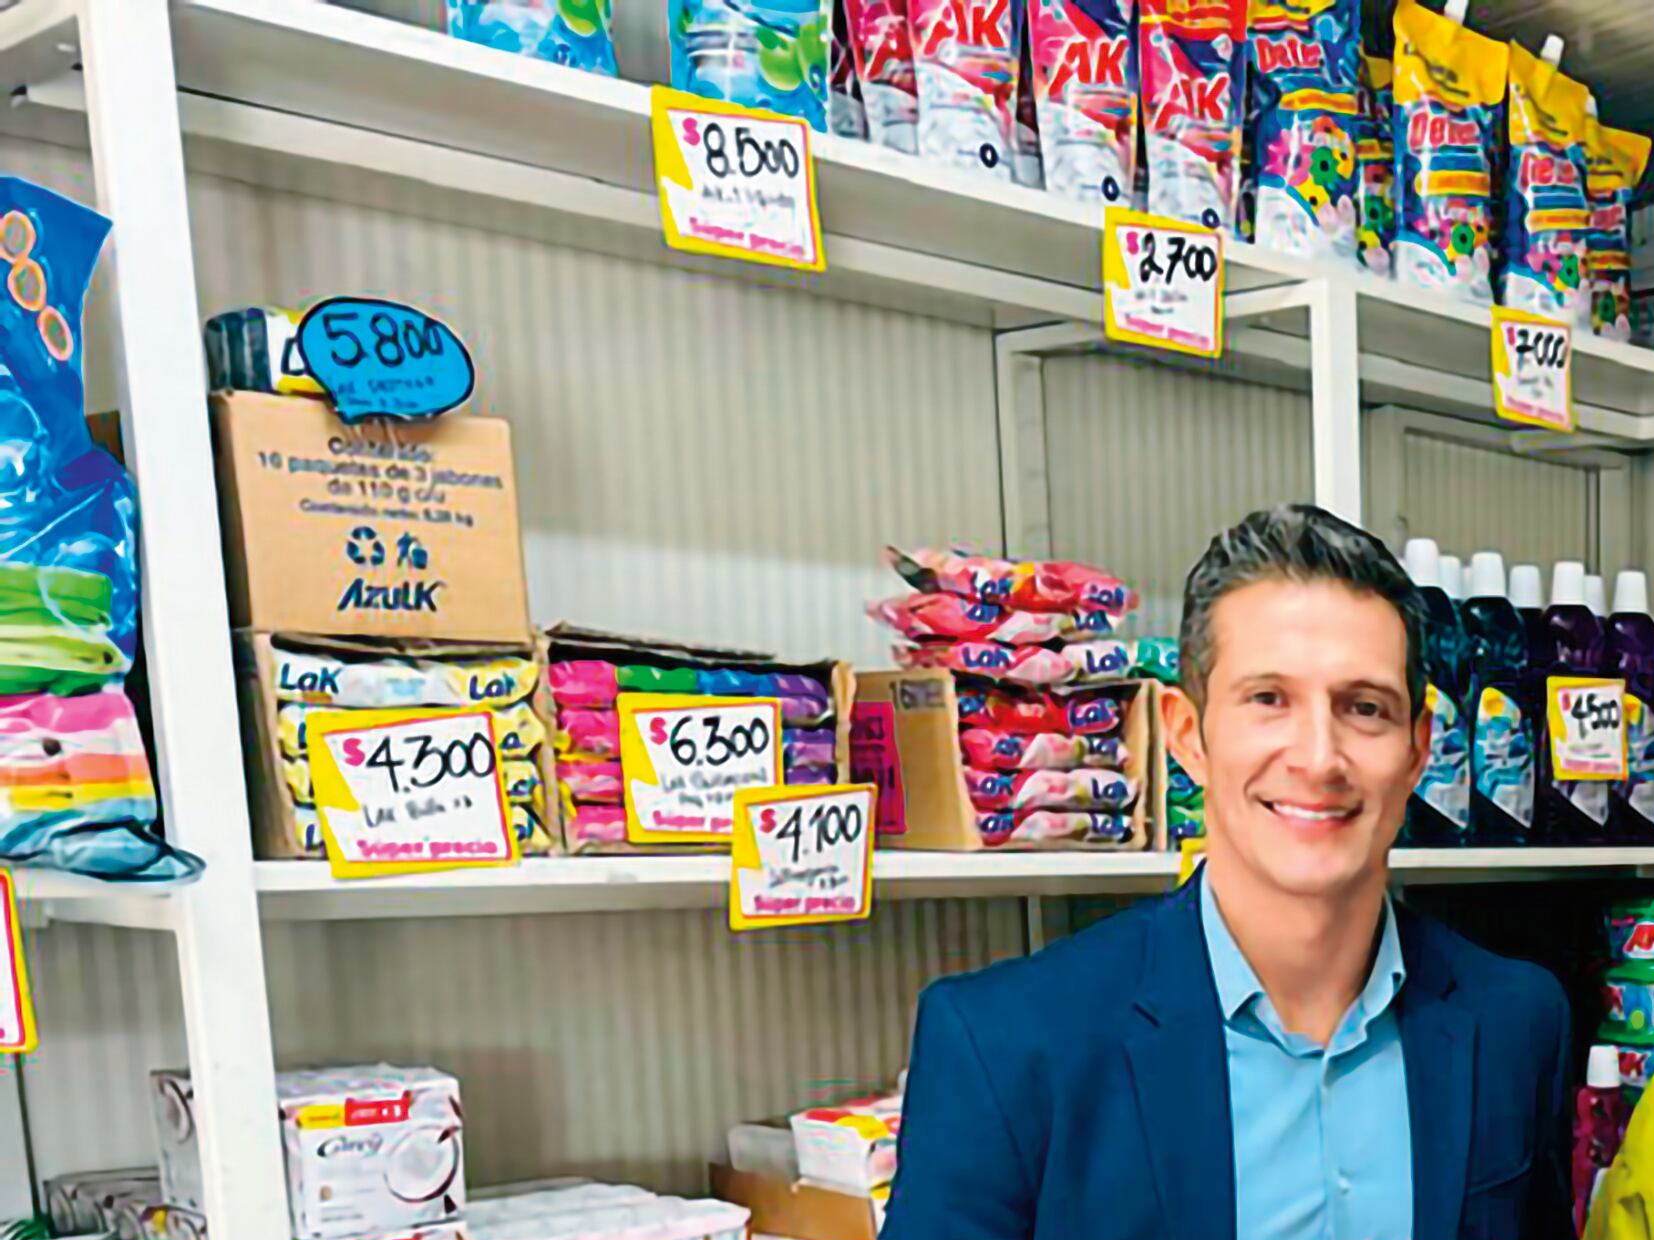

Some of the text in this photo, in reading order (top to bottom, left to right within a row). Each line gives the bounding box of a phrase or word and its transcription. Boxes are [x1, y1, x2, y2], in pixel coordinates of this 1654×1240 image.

[924, 0, 1008, 55] AK
[1049, 40, 1129, 96] AK
[1155, 74, 1230, 130] AK
